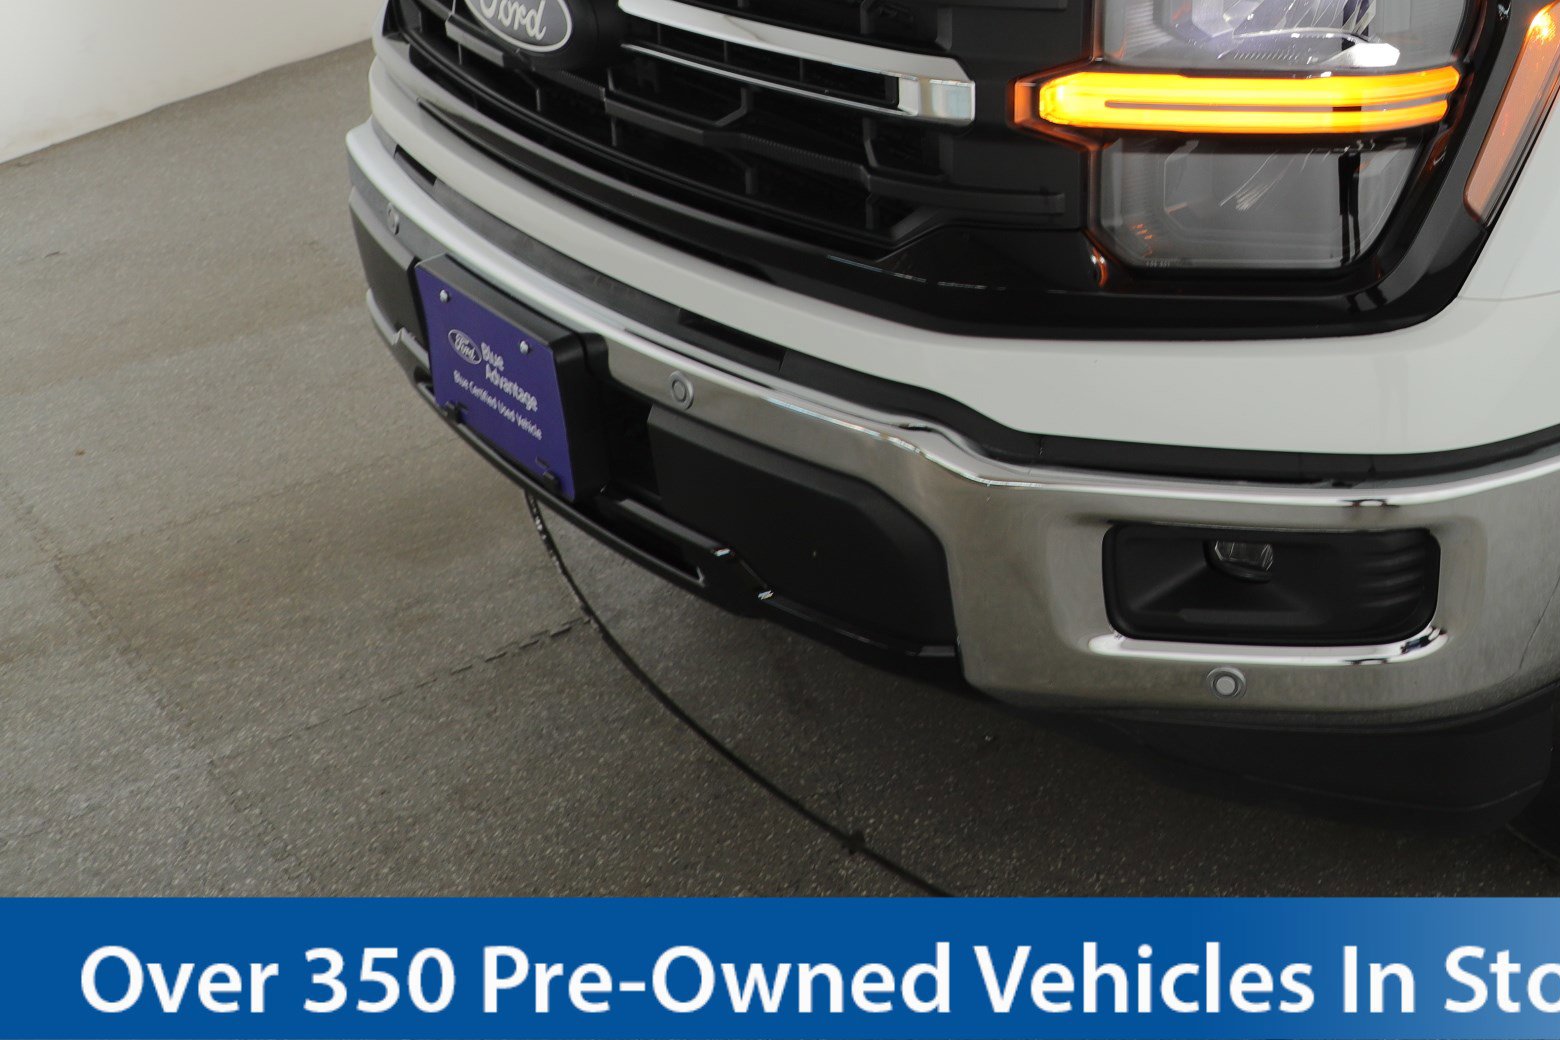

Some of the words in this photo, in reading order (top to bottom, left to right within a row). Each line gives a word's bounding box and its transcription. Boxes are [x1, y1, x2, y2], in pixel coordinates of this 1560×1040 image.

[454, 333, 477, 361] Ford
[481, 342, 504, 371] Blue
[453, 369, 469, 391] Blue
[469, 380, 498, 410] Certified
[497, 400, 516, 423] Used
[515, 412, 542, 441] Vehicle
[486, 363, 538, 412] Advantage
